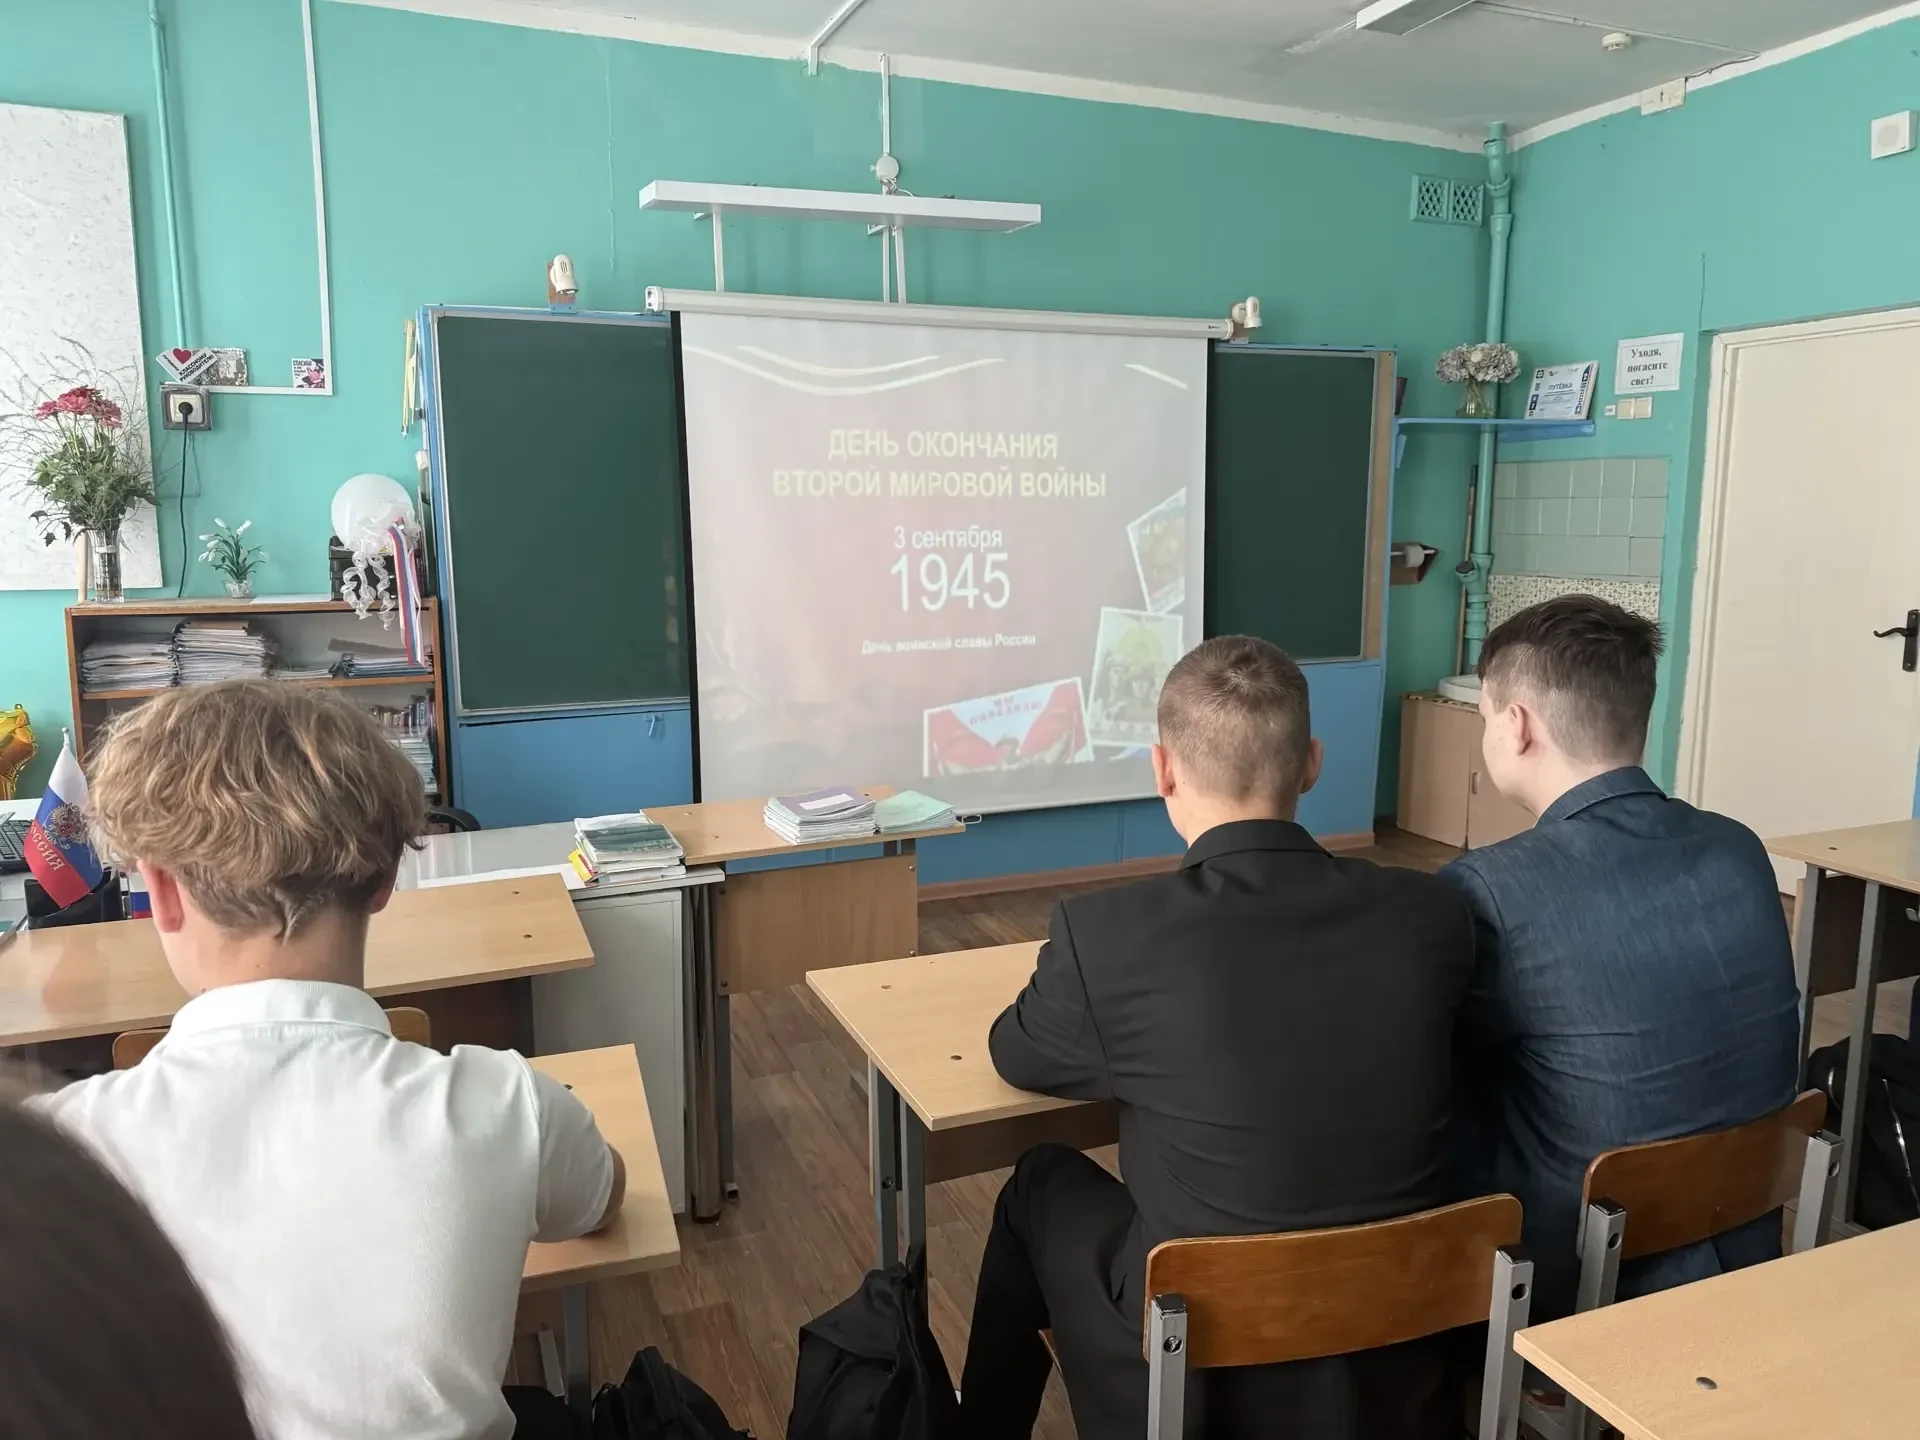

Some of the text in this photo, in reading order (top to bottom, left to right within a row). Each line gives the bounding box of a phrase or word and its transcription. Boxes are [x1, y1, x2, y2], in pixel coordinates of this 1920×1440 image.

[1627, 362, 1668, 373] погасите
[1630, 375, 1654, 386] свет!
[828, 429, 1059, 461] ДЕНЬ ОКОНЧАНИЯ
[772, 463, 1107, 498] ВТОРОЙ МИРОВОЙ ВОЙНЫ
[893, 524, 1004, 552] 3 сентября
[890, 552, 1010, 612] 1945
[954, 636, 993, 649] славы
[994, 633, 1037, 647] России
[30, 821, 65, 872] ОССИЯ
